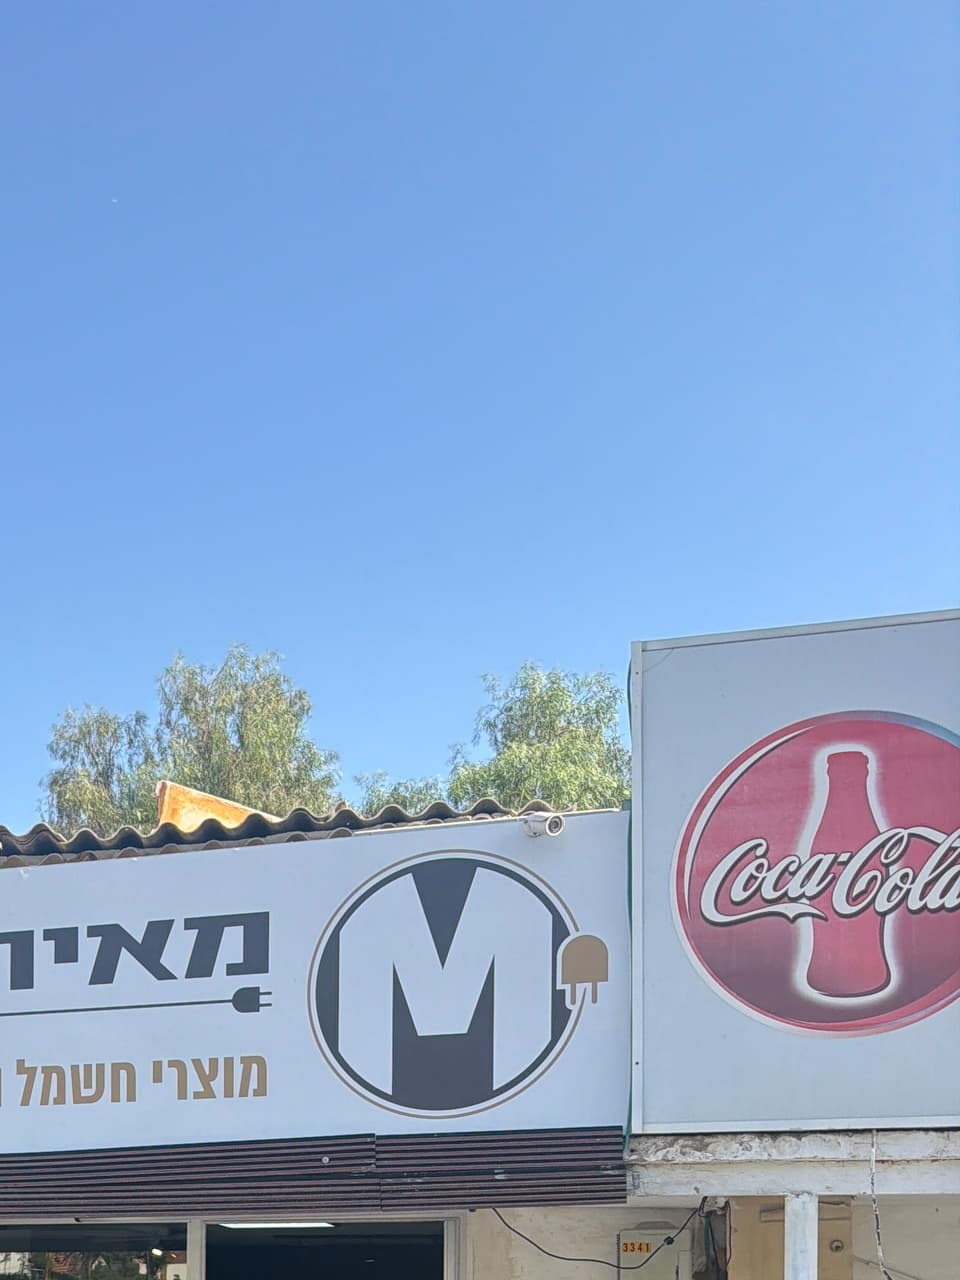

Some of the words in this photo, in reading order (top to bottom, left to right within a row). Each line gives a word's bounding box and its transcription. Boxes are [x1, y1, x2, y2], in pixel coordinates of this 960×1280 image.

[338, 865, 554, 1097] M
[15, 1058, 137, 1107] חשמל
[152, 1055, 268, 1100] מוצרי
[622, 1242, 650, 1253] 3341
